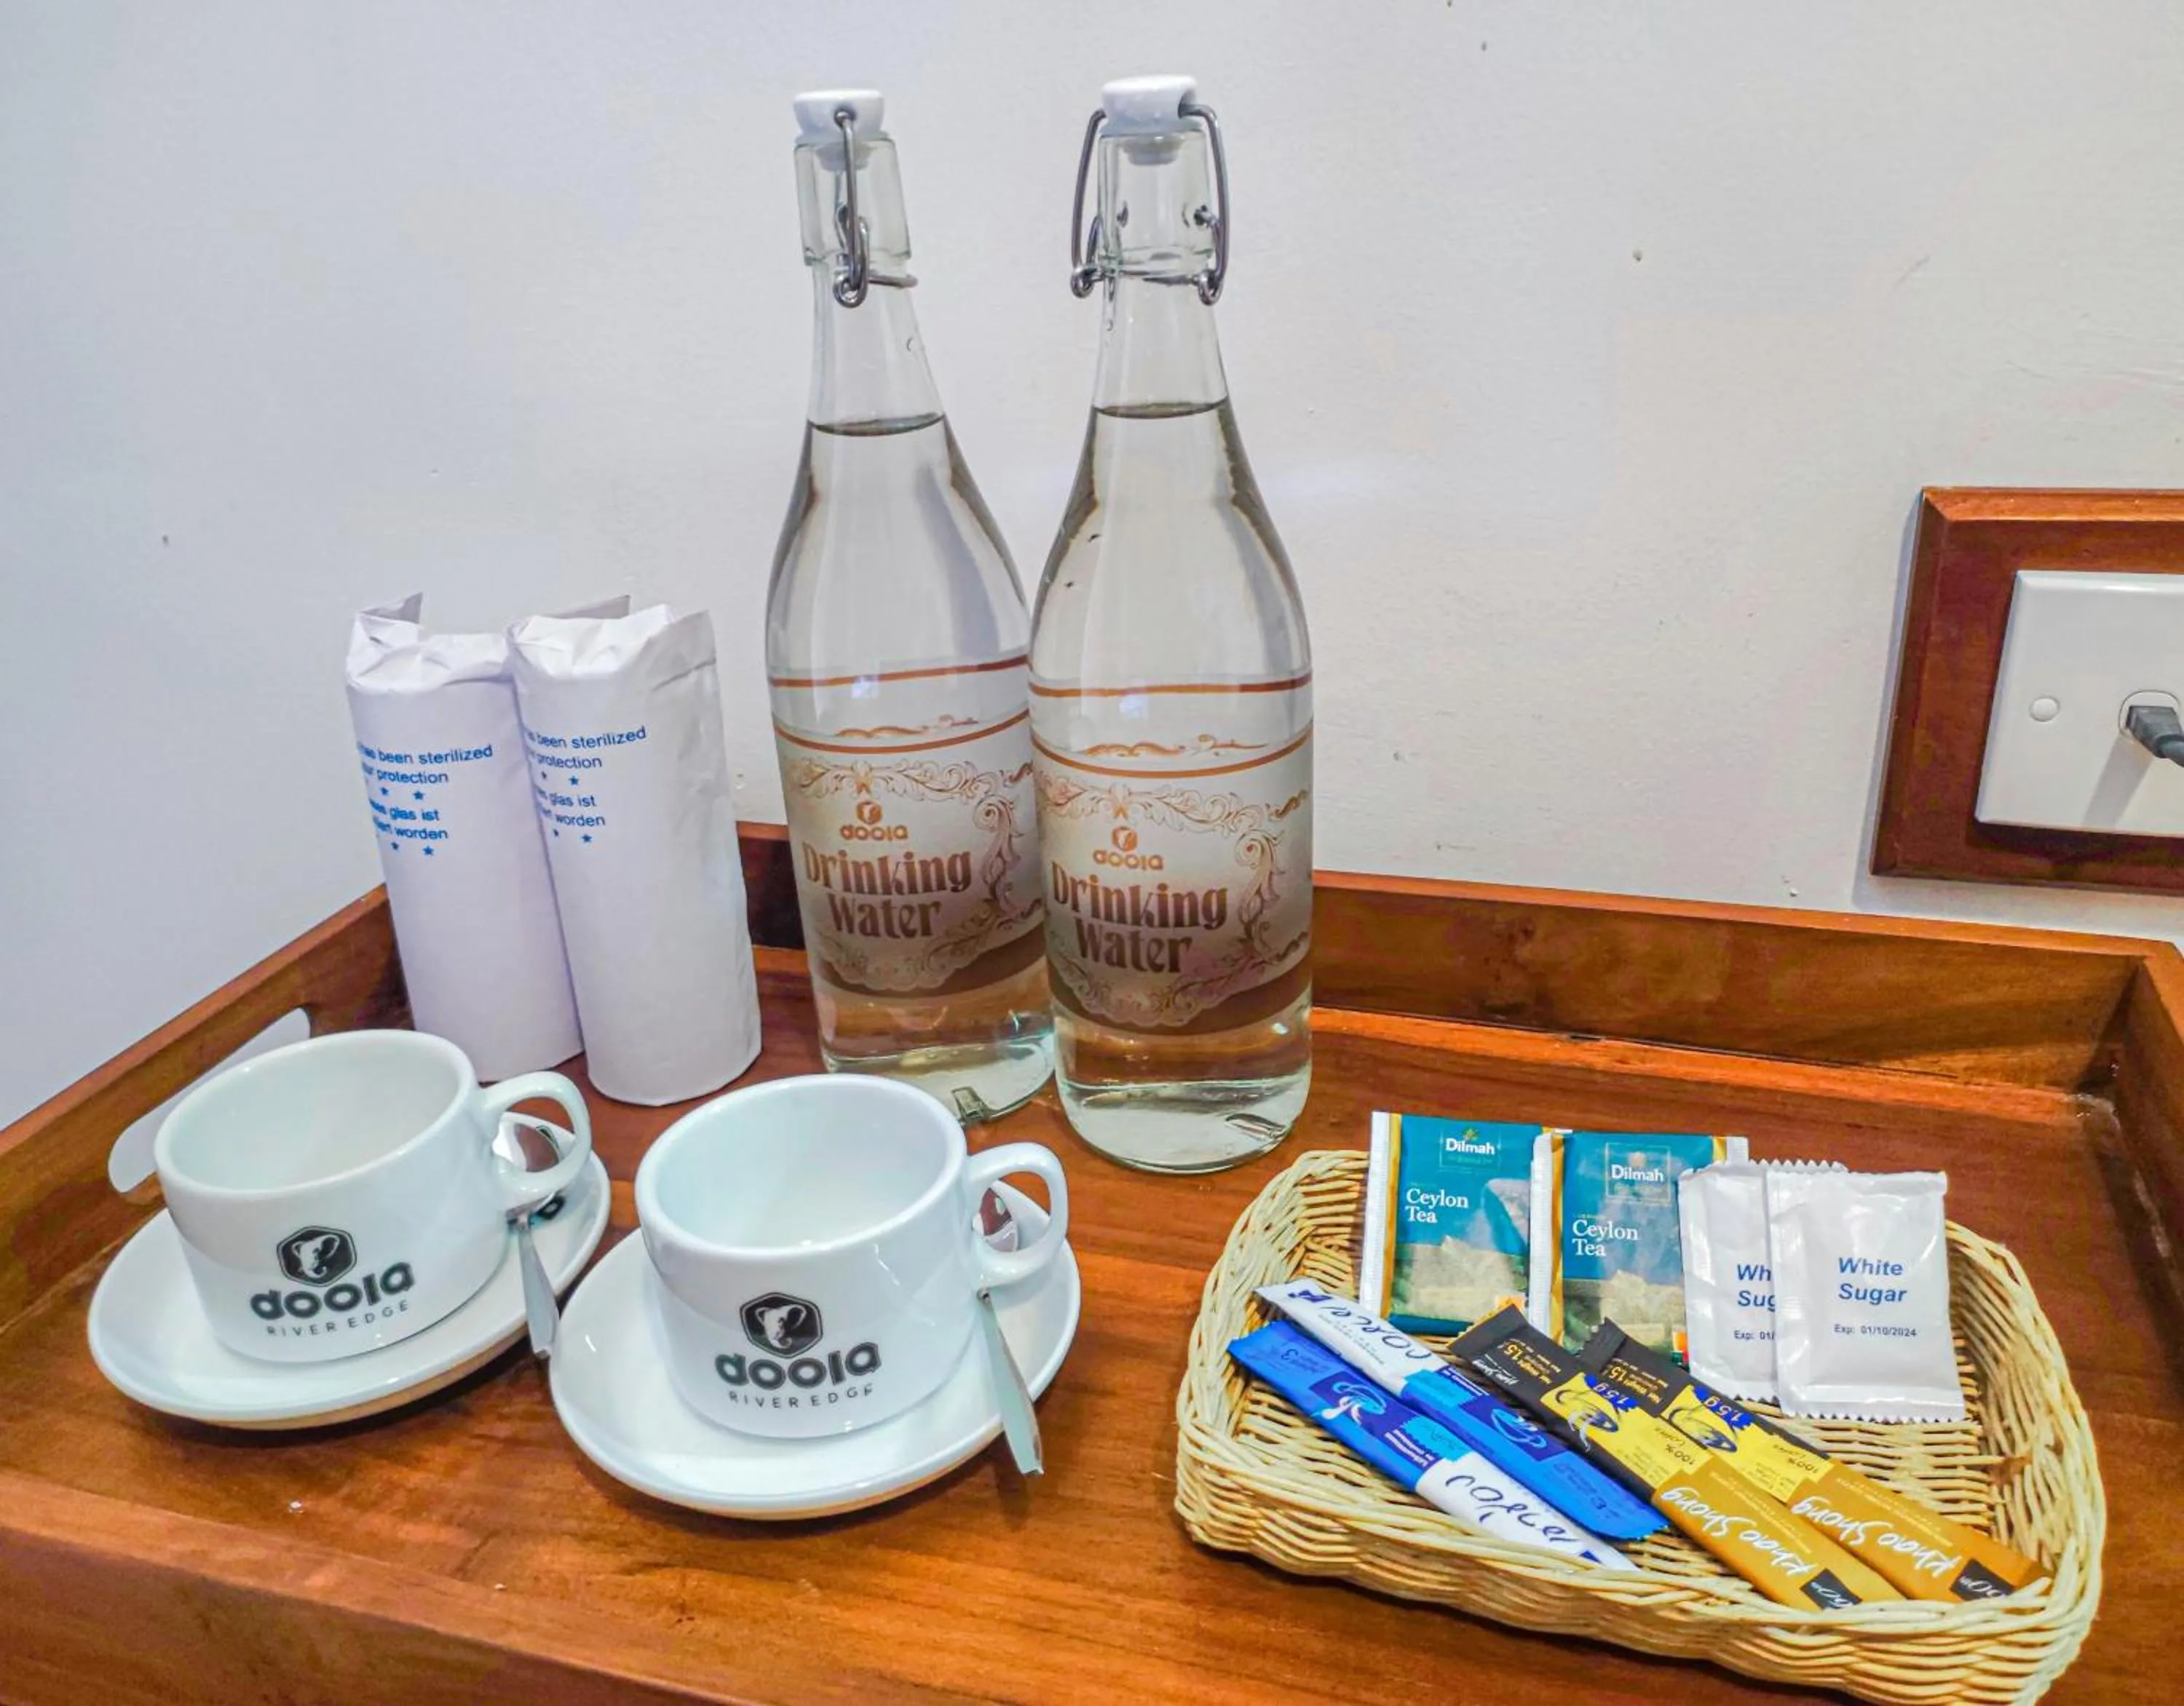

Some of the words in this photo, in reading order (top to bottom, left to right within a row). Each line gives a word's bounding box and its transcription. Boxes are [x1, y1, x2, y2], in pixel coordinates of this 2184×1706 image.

[571, 725, 646, 749] sterilized
[377, 749, 414, 764] been
[419, 745, 494, 765] sterilized
[537, 753, 603, 769] protection
[376, 769, 449, 785] protection
[422, 809, 440, 822] ist
[555, 813, 606, 827] worden
[395, 826, 449, 840] worden
[802, 841, 972, 896] Drinking
[1051, 861, 1228, 930] Drinking
[828, 894, 942, 940] Water
[1075, 916, 1193, 973] Water
[1445, 1137, 1495, 1155] Dilmah
[1611, 1165, 1664, 1183] Dilmah
[1406, 1188, 1469, 1209] Ceylon
[1405, 1205, 1438, 1223] Tea
[1572, 1219, 1638, 1242] Ceylon
[1572, 1239, 1607, 1256] Tea
[1838, 1257, 1904, 1277] White
[1838, 1283, 1908, 1306] Sugar
[1860, 1325, 1918, 1338] 01/10/2024
[1661, 1487, 1757, 1537] Shong
[1790, 1496, 1894, 1545] Shong
[1738, 1530, 1819, 1576] Khao
[1877, 1532, 1963, 1578] Khao
